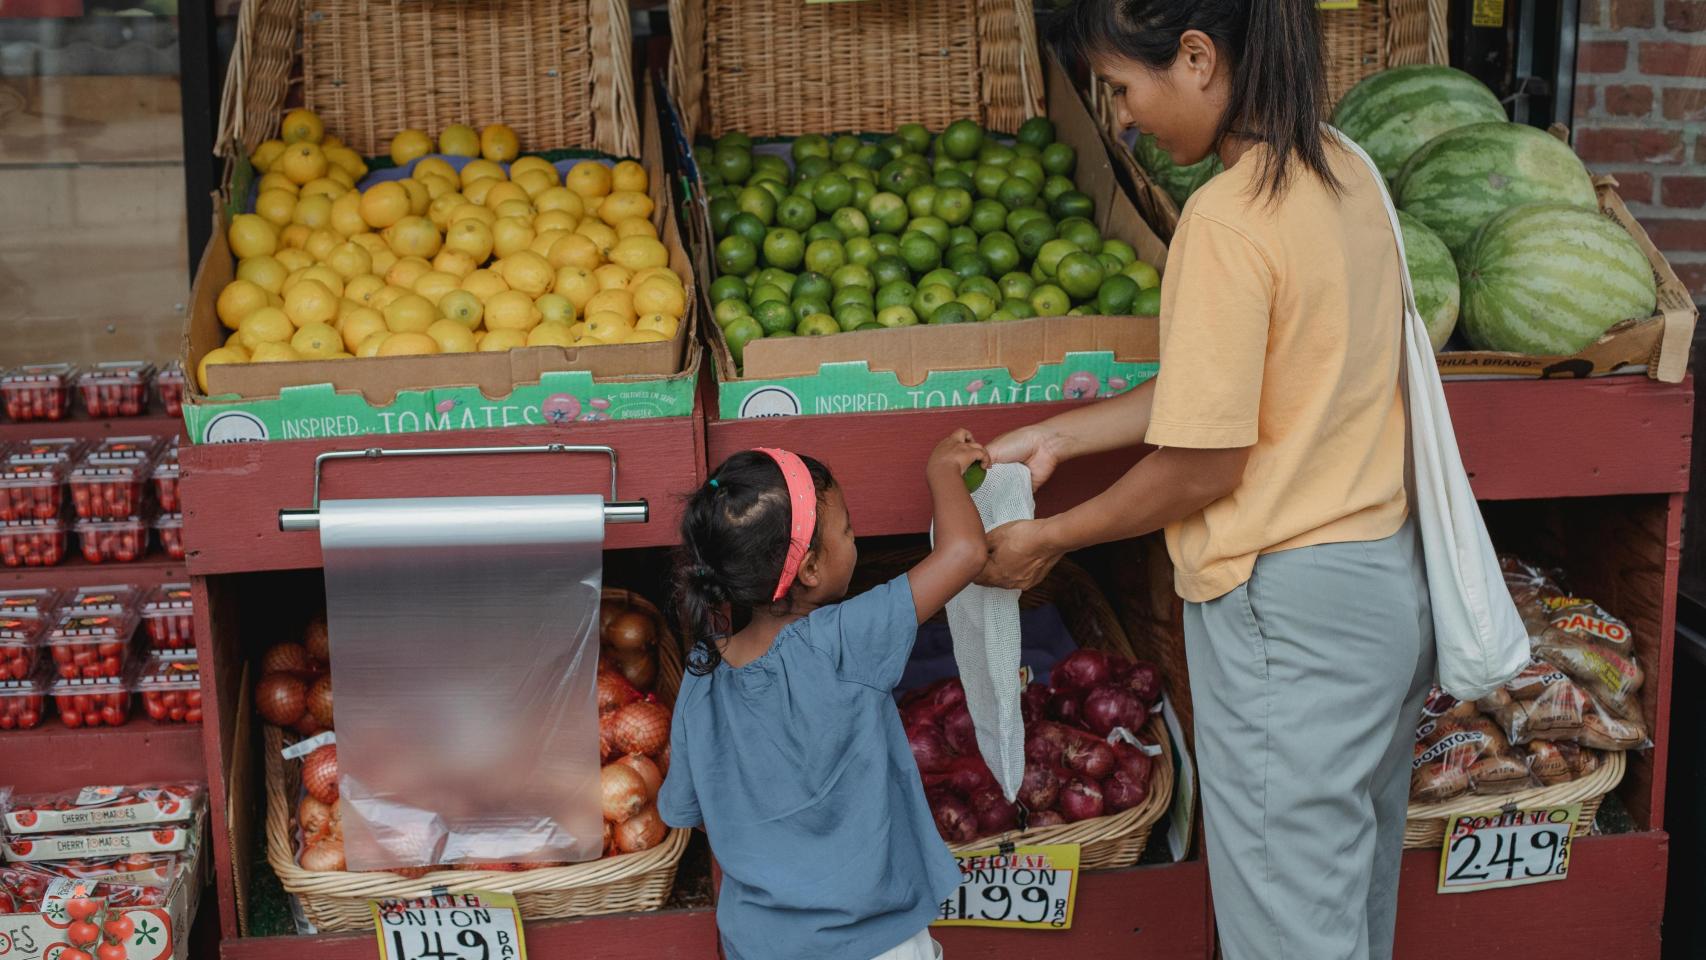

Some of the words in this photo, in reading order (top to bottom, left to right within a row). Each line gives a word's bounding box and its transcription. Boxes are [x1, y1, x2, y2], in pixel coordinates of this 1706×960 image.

[1412, 731, 1484, 769] POTATOES
[61, 813, 89, 824] CHERRY
[57, 840, 84, 852] CHERRY
[1446, 830, 1559, 880] 2.49
[382, 908, 491, 927] ONION
[1050, 898, 1067, 928] BAG
